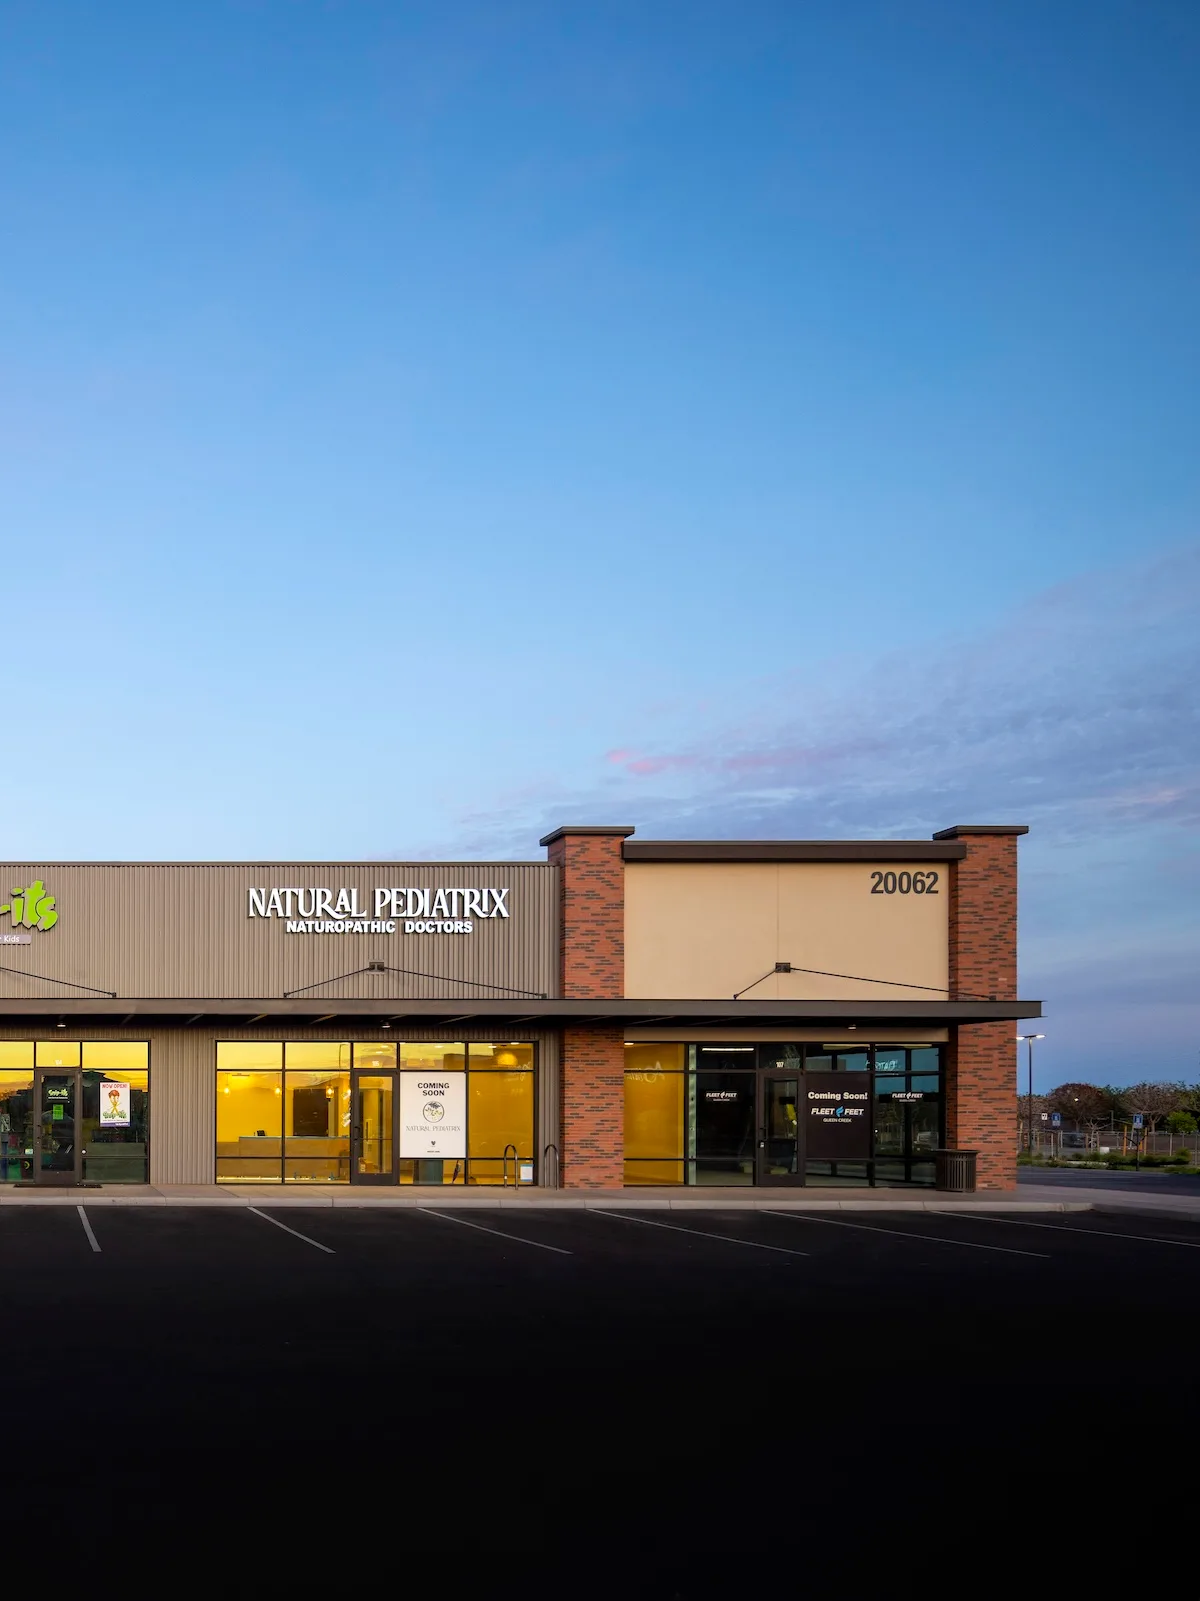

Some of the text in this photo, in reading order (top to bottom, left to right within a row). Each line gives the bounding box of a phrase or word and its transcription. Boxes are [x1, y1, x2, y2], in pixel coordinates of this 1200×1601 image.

[870, 871, 939, 894] 20062
[248, 887, 510, 919] NATURAL PEDIATRIX
[286, 920, 473, 934] NATUROPATHIC DOCTORS
[3, 934, 21, 943] Kids
[808, 1092, 868, 1100] Coming Soon!
